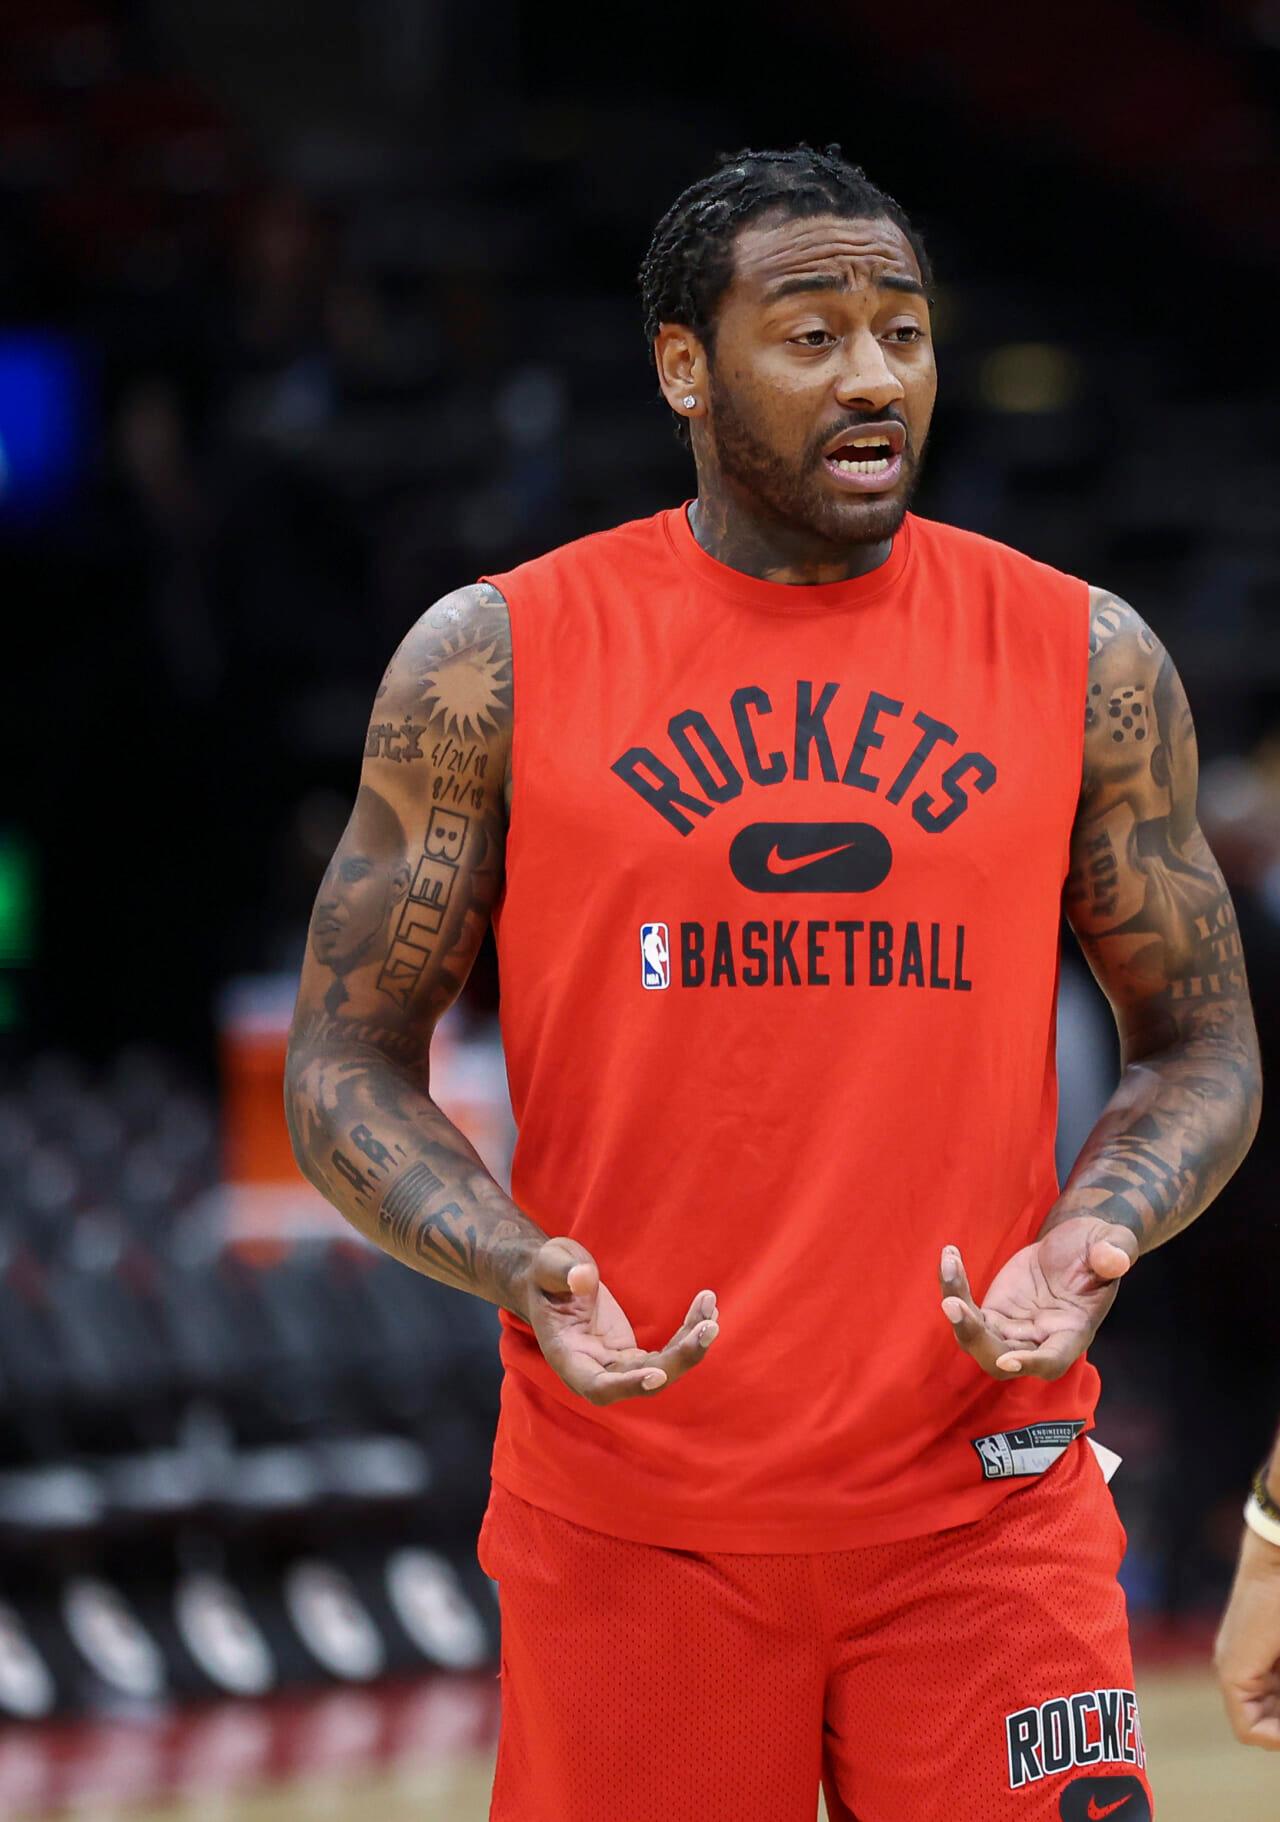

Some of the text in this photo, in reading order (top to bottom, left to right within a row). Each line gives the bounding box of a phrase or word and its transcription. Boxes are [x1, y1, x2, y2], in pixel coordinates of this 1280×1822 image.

[610, 680, 997, 837] ROCKETS
[680, 920, 972, 991] BASKETBALL
[1014, 1435, 1024, 1444] L
[1006, 1689, 1145, 1789] ROCKE
